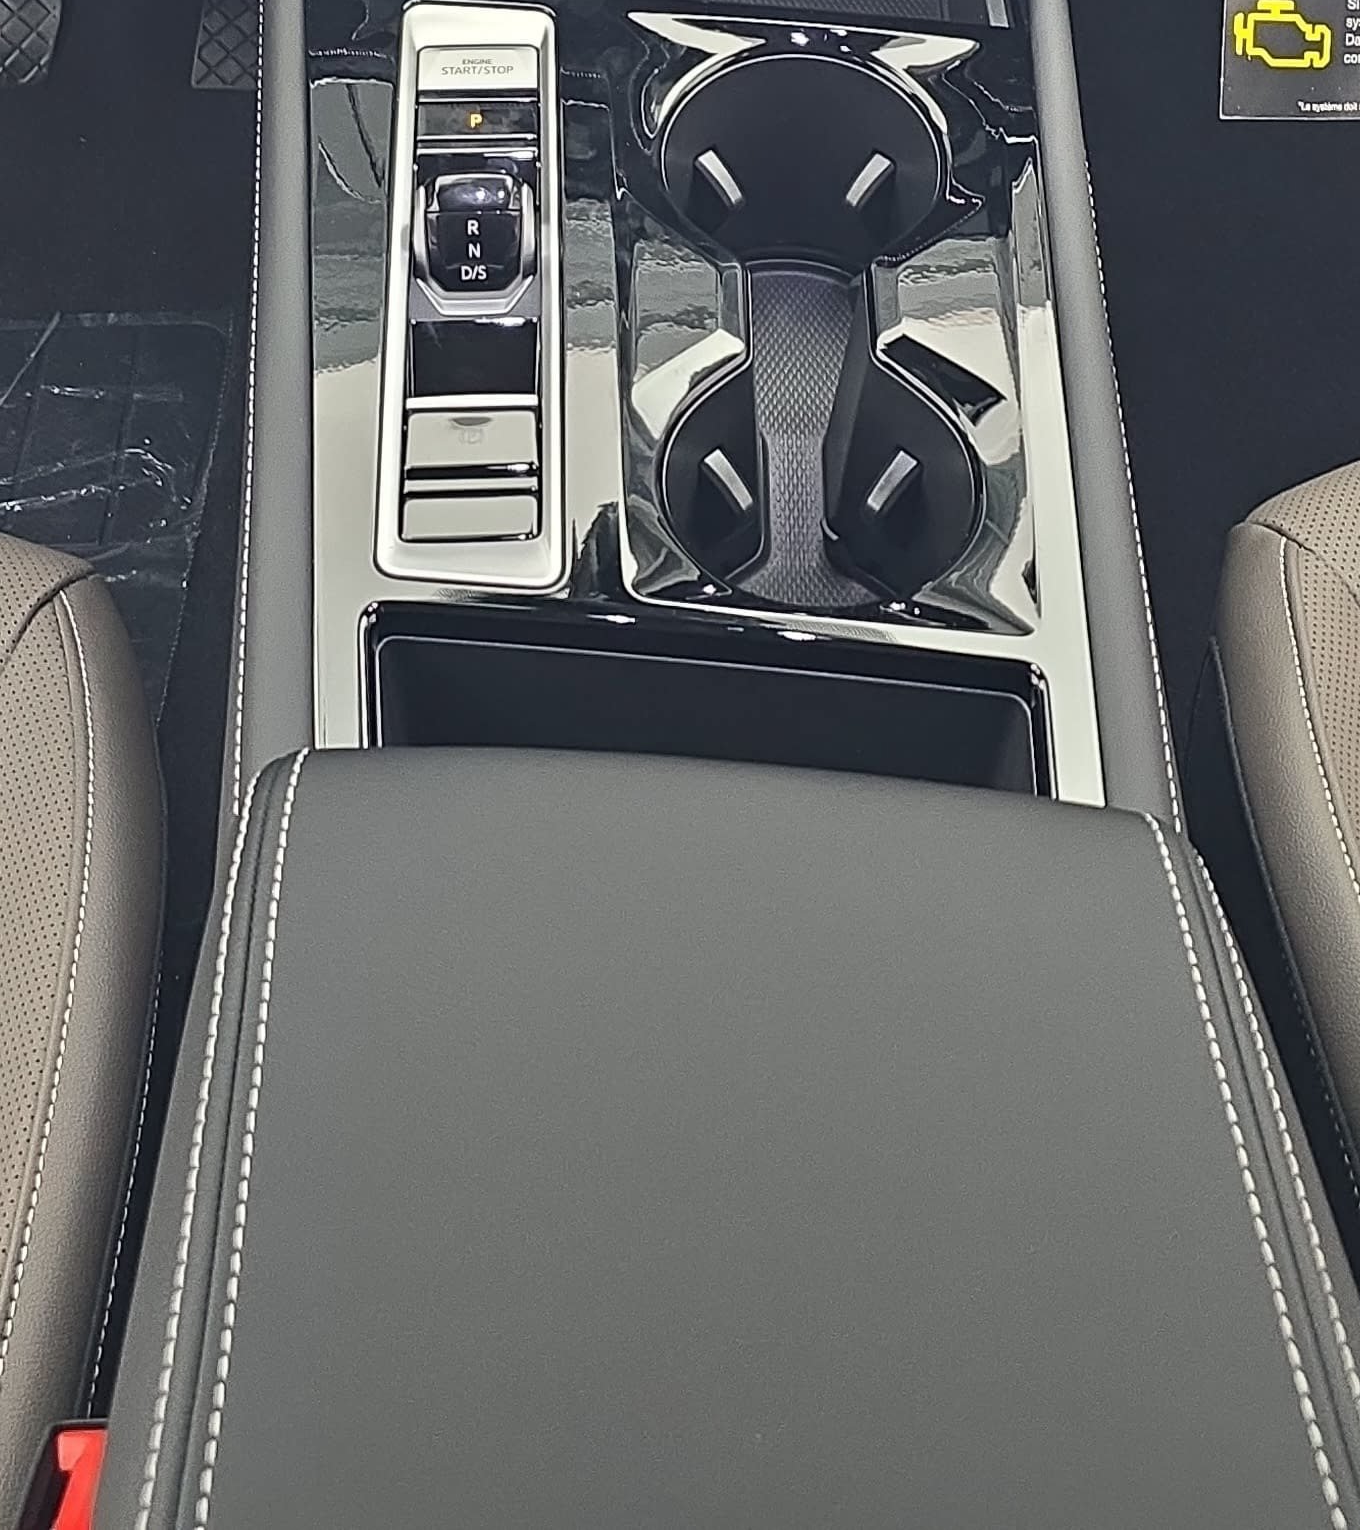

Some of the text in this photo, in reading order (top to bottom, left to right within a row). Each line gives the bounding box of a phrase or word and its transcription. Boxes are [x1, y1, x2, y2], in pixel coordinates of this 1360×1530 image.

[441, 65, 514, 76] START/STOP
[470, 113, 483, 129] P
[467, 220, 479, 235] R
[469, 243, 481, 259] N
[461, 266, 488, 281] D/S
